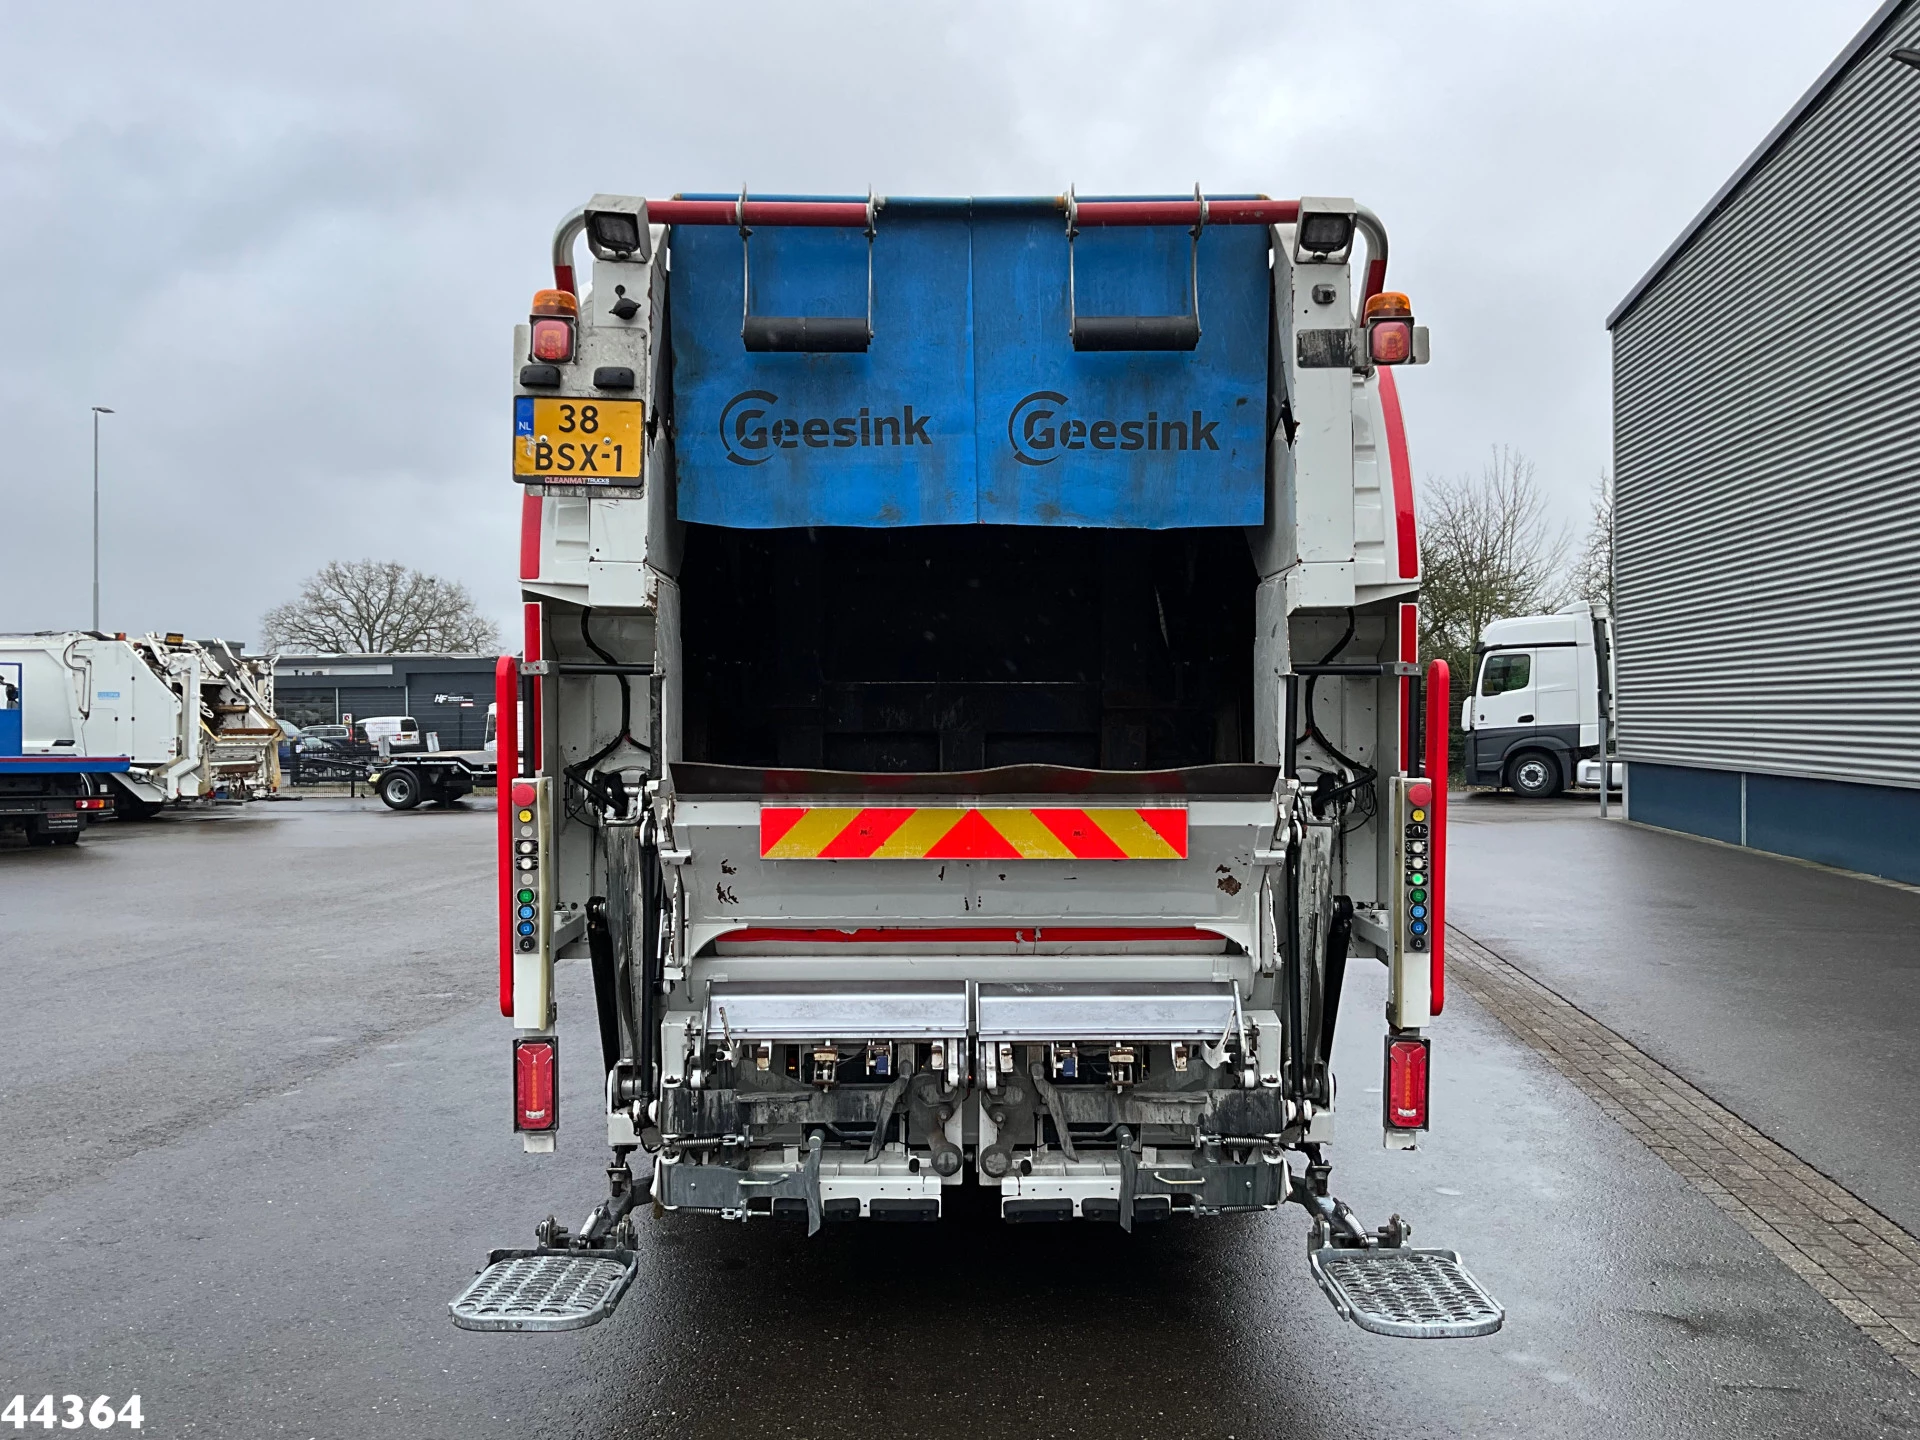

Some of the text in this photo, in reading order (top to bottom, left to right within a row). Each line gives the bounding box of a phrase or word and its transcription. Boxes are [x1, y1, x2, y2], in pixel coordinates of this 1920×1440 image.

[518, 421, 532, 431] NL
[558, 404, 599, 434] 38
[735, 405, 933, 450] Geesink
[1023, 410, 1221, 450] Geesink
[535, 443, 623, 472] BSX-1
